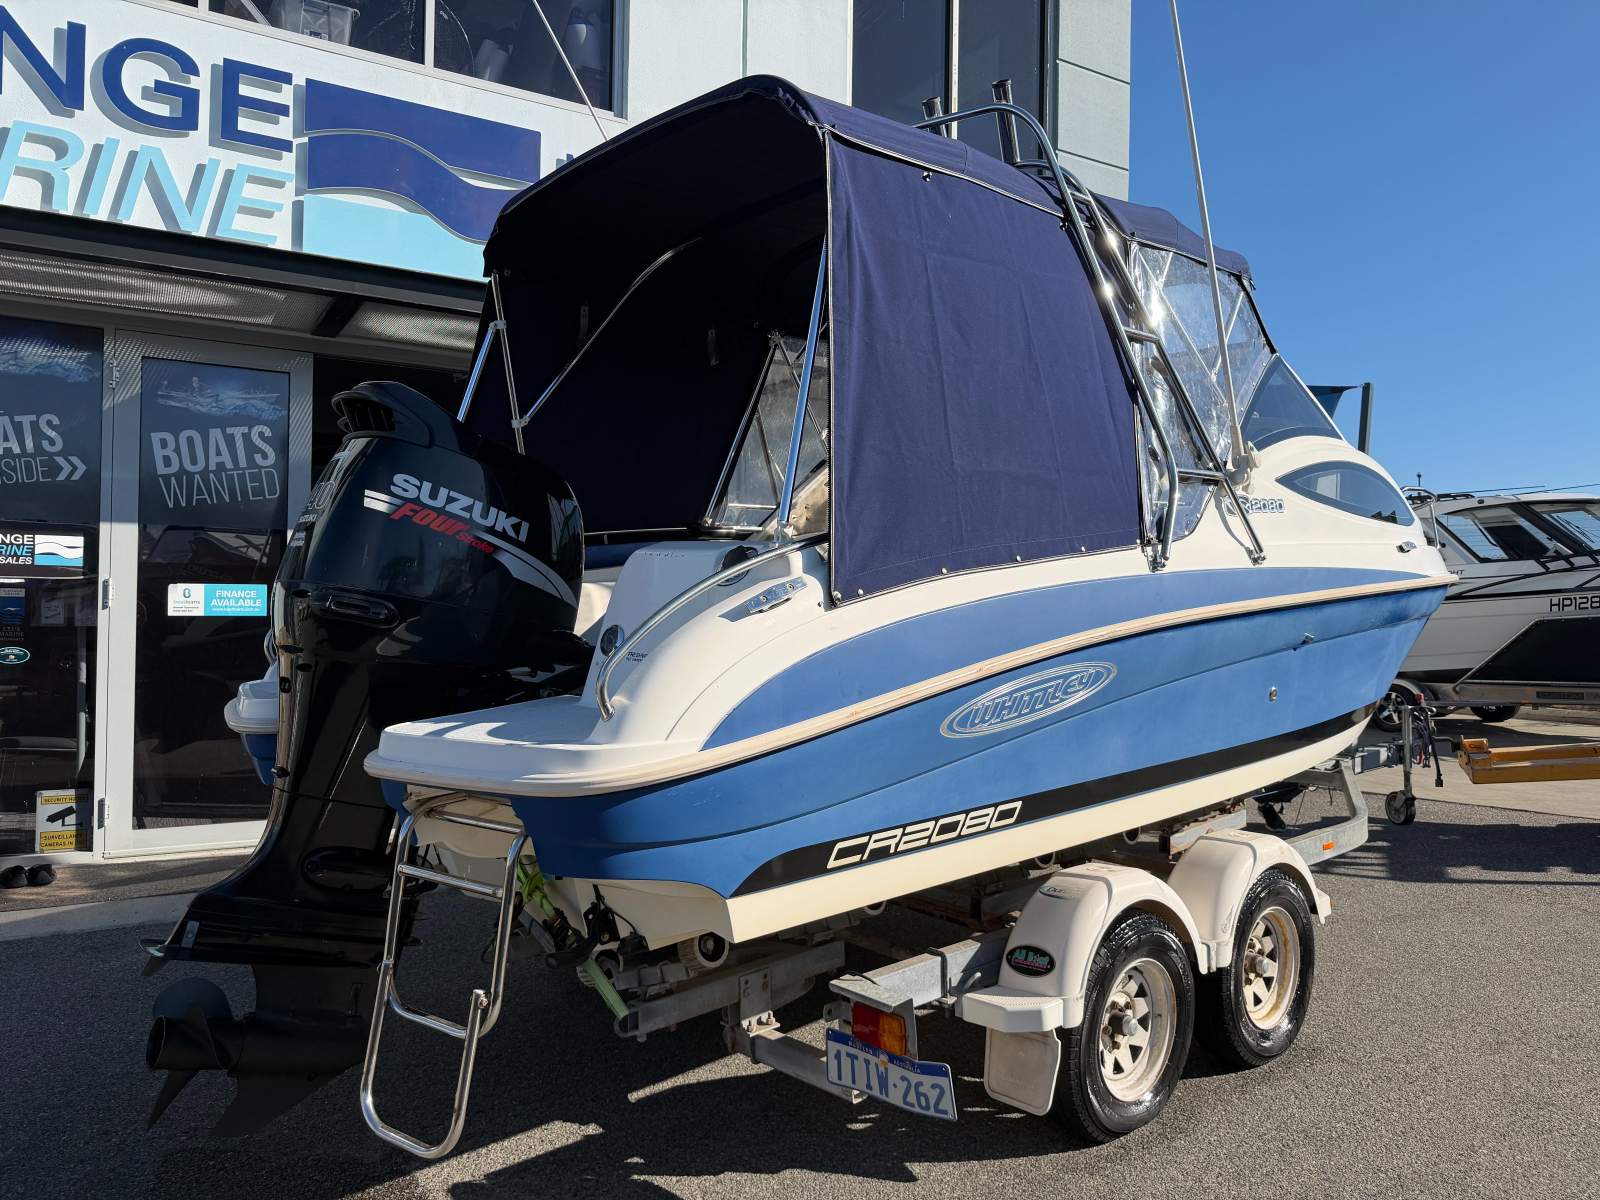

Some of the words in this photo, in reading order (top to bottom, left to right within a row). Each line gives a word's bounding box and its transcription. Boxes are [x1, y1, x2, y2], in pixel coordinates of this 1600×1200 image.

[0, 4, 293, 153] NGE
[0, 120, 294, 246] RINE
[150, 424, 276, 475] BOATS
[159, 468, 280, 509] WANTED
[390, 473, 529, 543] SUZUKI
[0, 533, 34, 545] NGE
[0, 556, 33, 565] SALES
[210, 598, 262, 607] AVAILABLE
[216, 590, 257, 598] FINANCE
[826, 800, 1023, 870] CR2080
